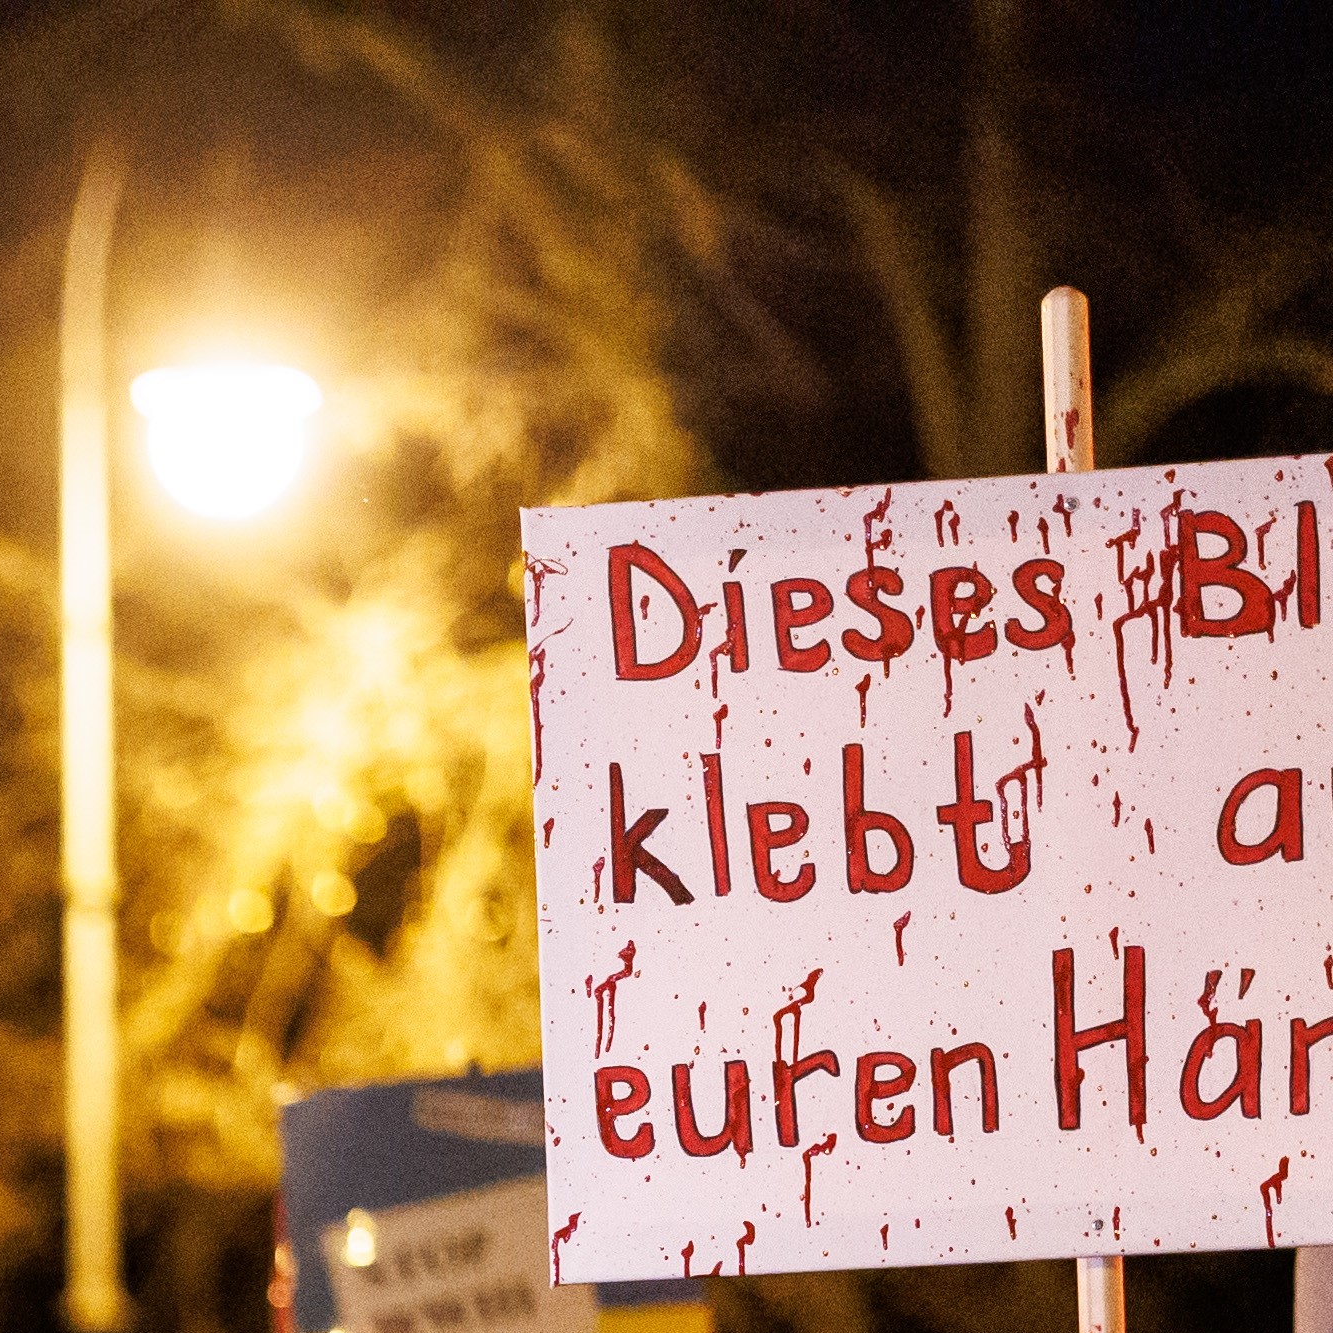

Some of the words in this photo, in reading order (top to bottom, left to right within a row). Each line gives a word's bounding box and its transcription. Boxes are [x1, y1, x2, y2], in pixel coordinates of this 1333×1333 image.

[607, 541, 1074, 681] Dieses
[609, 730, 1031, 905] klebt
[1217, 766, 1333, 866] a
[593, 1040, 1000, 1159] euren
